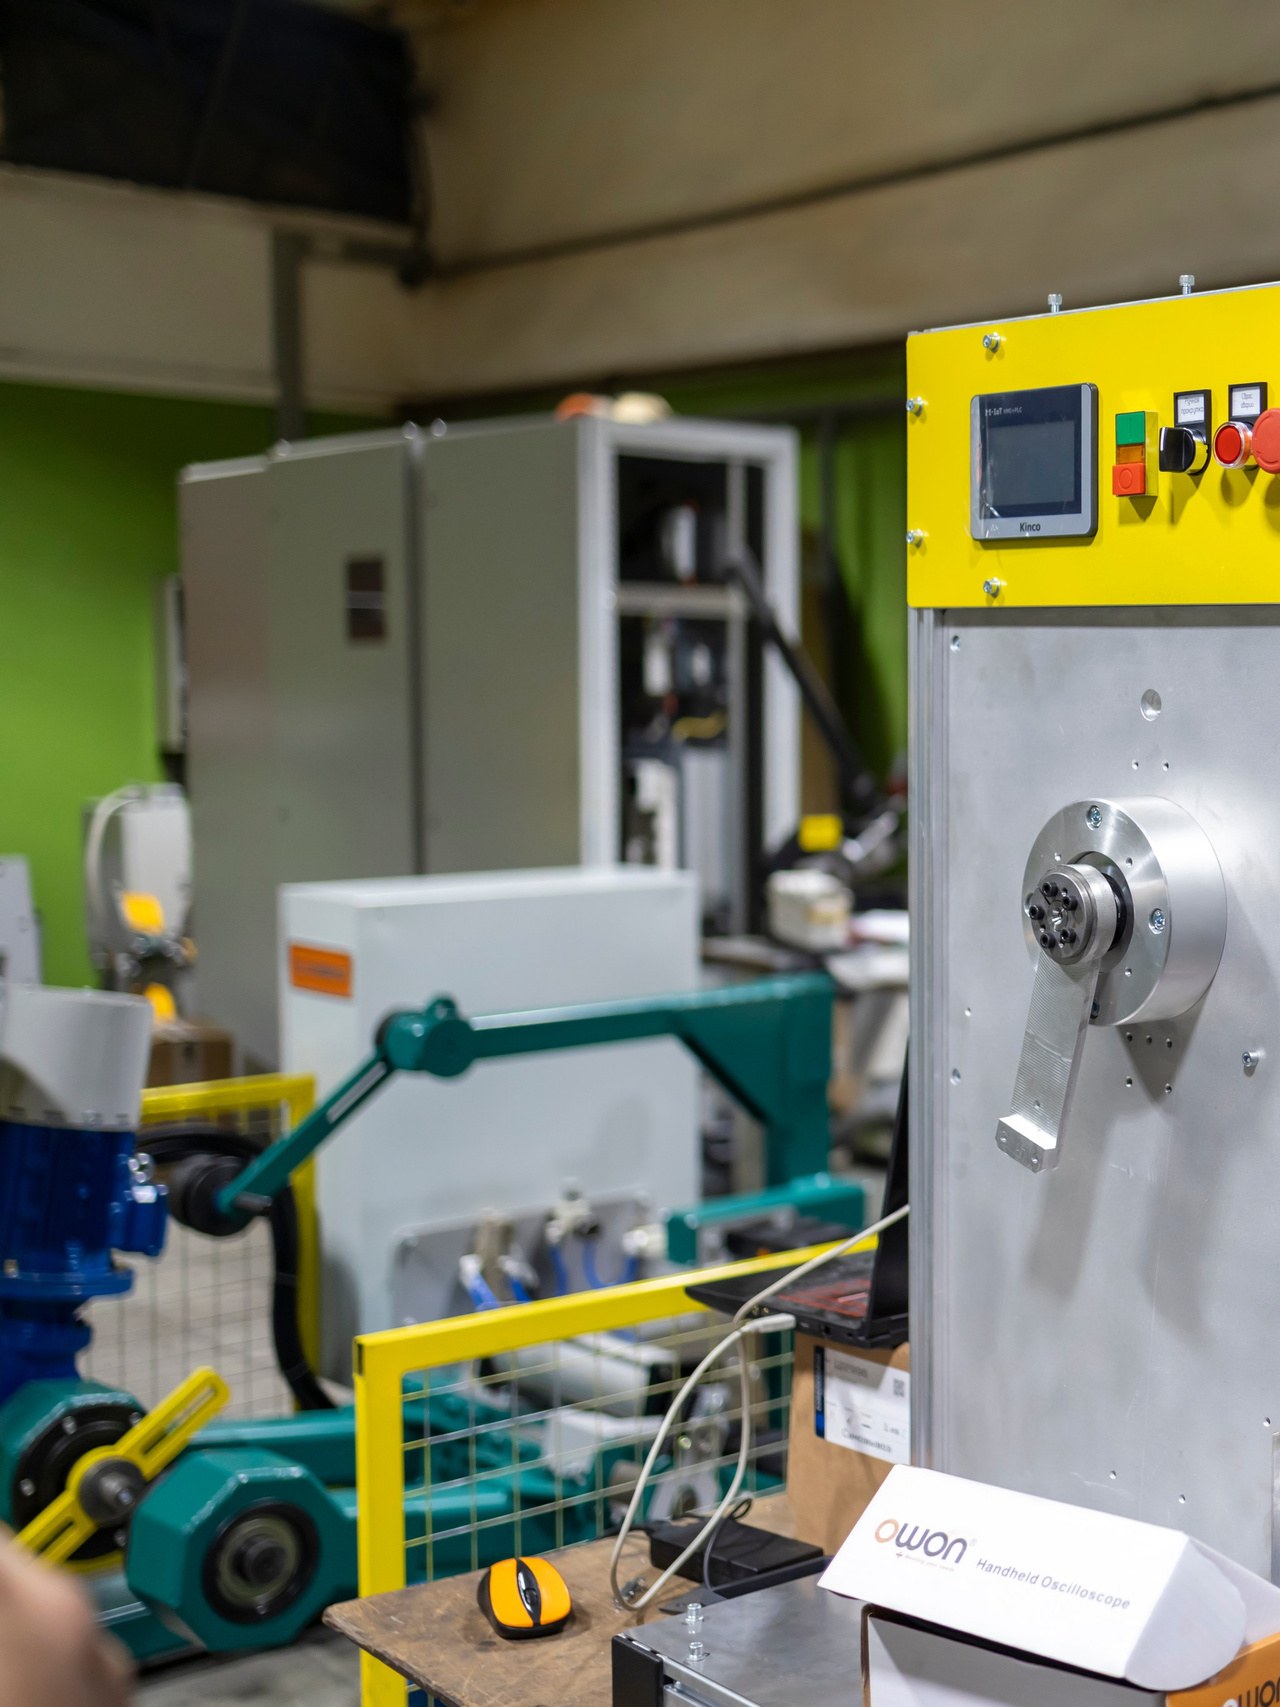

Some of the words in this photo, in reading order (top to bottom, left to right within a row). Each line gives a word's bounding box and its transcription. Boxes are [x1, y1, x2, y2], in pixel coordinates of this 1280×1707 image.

[1020, 522, 1041, 532] Kinco
[976, 1558, 1040, 1585] Handheld
[1041, 1576, 1130, 1609] Oscilloscope
